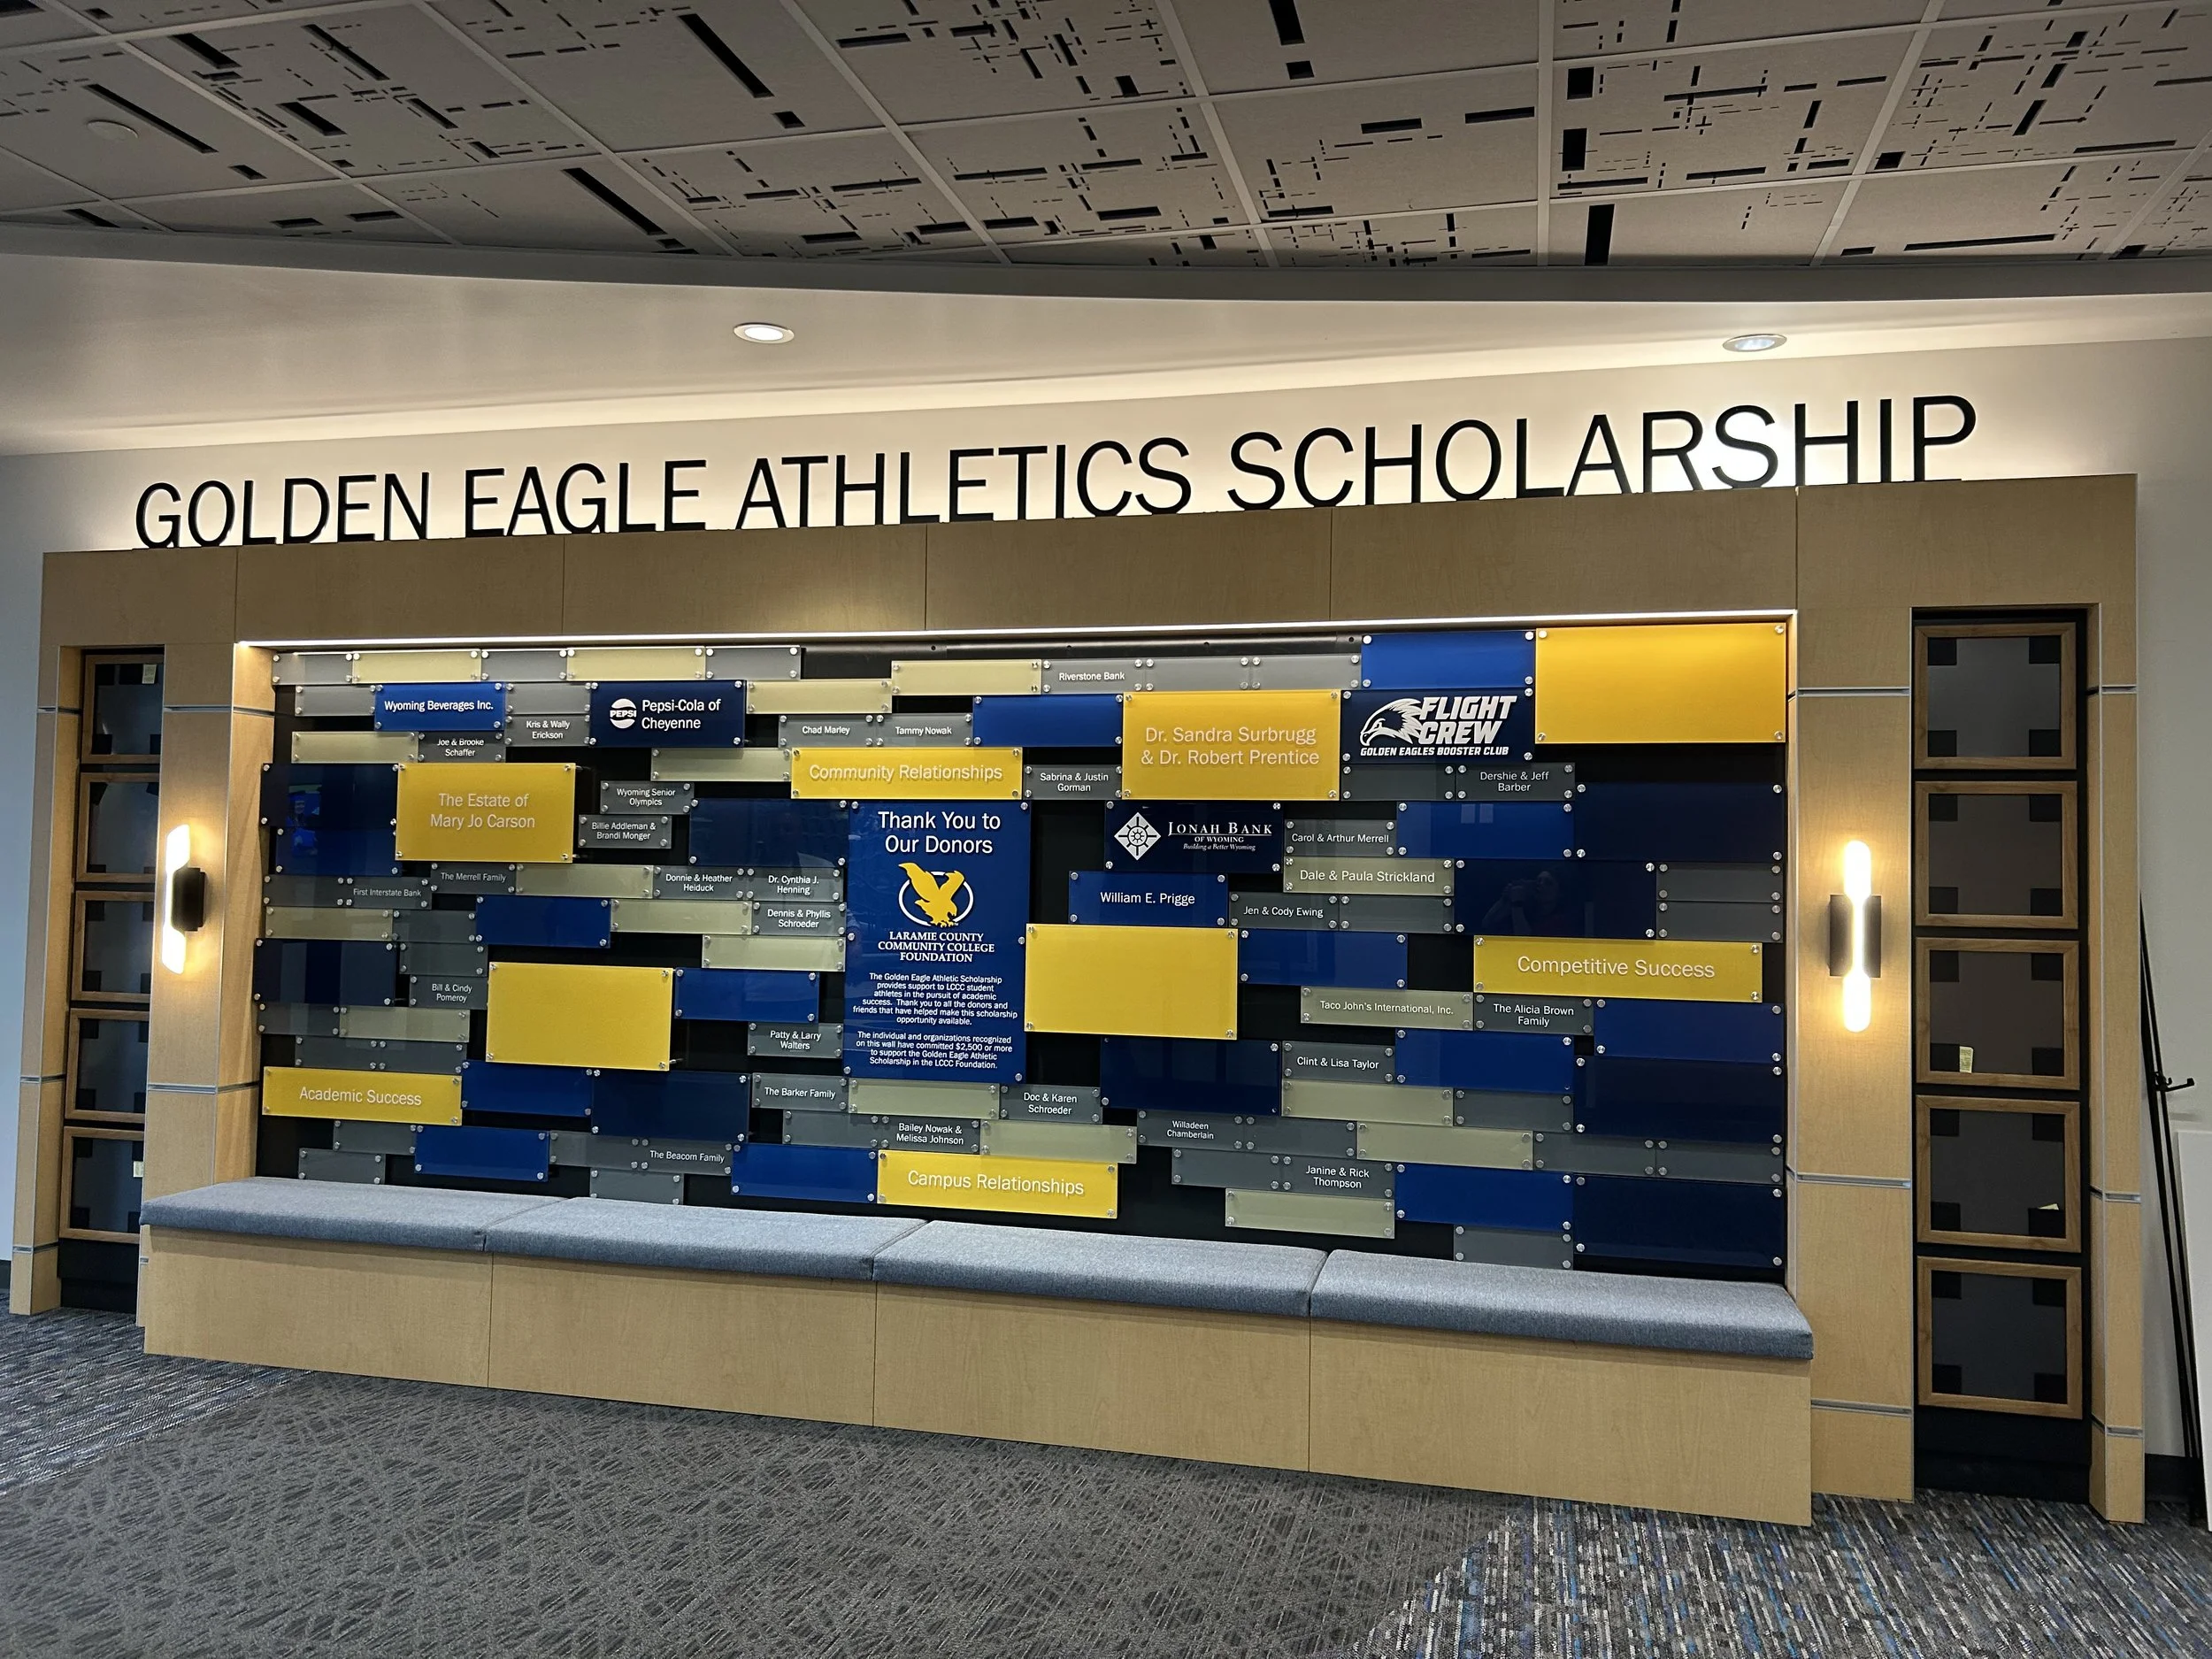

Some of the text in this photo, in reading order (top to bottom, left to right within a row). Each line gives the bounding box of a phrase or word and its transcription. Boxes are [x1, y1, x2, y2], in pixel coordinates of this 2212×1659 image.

[135, 395, 1978, 549] GOLDEN EAGLE ATHLETICS SCHOLARSHIP
[384, 700, 494, 712] Wyoming Beverages Inc.
[642, 698, 721, 714] Pepsi-Cola of
[1419, 695, 1518, 720] FLIGHT
[550, 720, 570, 729] Wally
[641, 717, 701, 731] Cheyenne
[802, 726, 850, 735] Chad Marley
[895, 726, 924, 736] Tammy
[1146, 726, 1317, 745] Dr. Sandra Surbrugg
[1417, 720, 1502, 745] CREW
[1141, 749, 1320, 764] & Dr. Robert Prentice
[1360, 747, 1509, 756] GOLDEN EAGLES BOOSTER CLUB
[809, 764, 1002, 782] Community Relationships
[1040, 772, 1109, 781] Sabrina & Justin
[1480, 772, 1549, 780] Dershie & Jeff
[1498, 782, 1531, 791] Barber
[617, 788, 650, 798] Wyoming
[439, 793, 529, 807] The Estate of
[629, 797, 663, 807] Olympics
[430, 814, 535, 830] Mary Jo Carson
[878, 811, 1001, 830] Thank You to
[1168, 821, 1272, 836] JONAH BANK
[1292, 833, 1389, 842] Carol & Arthur Merrell
[885, 835, 993, 853] Our Donors
[456, 872, 481, 881] Merrell
[483, 872, 506, 883] Family
[781, 875, 810, 885] Cynthia
[1301, 870, 1435, 883] Dale & Paula Strickland
[683, 883, 714, 892] Heiduck
[777, 885, 810, 895] Henning
[1100, 892, 1195, 906] William E. Prigge
[767, 909, 795, 918] Dennis
[805, 910, 831, 919] Phyllis
[1243, 906, 1324, 918] Jen & Cody Ewing
[779, 918, 819, 927] Schroeder
[889, 931, 984, 941] LARAMIE COUNTY
[878, 941, 995, 952] COMMUNITY COLLEGE
[900, 952, 973, 963] FOUNDATION
[1517, 956, 1715, 978] Competitive Success
[910, 973, 931, 983] Eagle
[959, 975, 1002, 984] Scholarship
[452, 984, 472, 994] Cindy
[436, 993, 467, 1003] Pomeroy
[1320, 1000, 1453, 1014] Taco John's International, Inc.
[1494, 1003, 1574, 1015] The Alicia Brown
[1518, 1016, 1550, 1028] Family
[770, 1030, 790, 1041] Patty
[801, 1032, 821, 1041] Larry
[780, 1041, 810, 1049] Walters
[1297, 1056, 1379, 1071] Clint & Lisa Taylor
[299, 1087, 422, 1106] Academic Success
[764, 1087, 835, 1100] The Barker Family
[1024, 1092, 1077, 1102] Doc & Karen
[1028, 1104, 1072, 1115] Schroeder
[898, 1123, 963, 1134] Bailey Nowak &
[1171, 1120, 1209, 1130] Willadeen
[896, 1133, 964, 1145] Melissa Johnson
[1167, 1129, 1214, 1140] Chamberlain
[649, 1150, 664, 1159] The
[699, 1153, 725, 1164] Family
[1306, 1165, 1370, 1178] Janine & Rick
[908, 1170, 1084, 1196] Campus Relationships
[1313, 1177, 1362, 1189] Thompson
